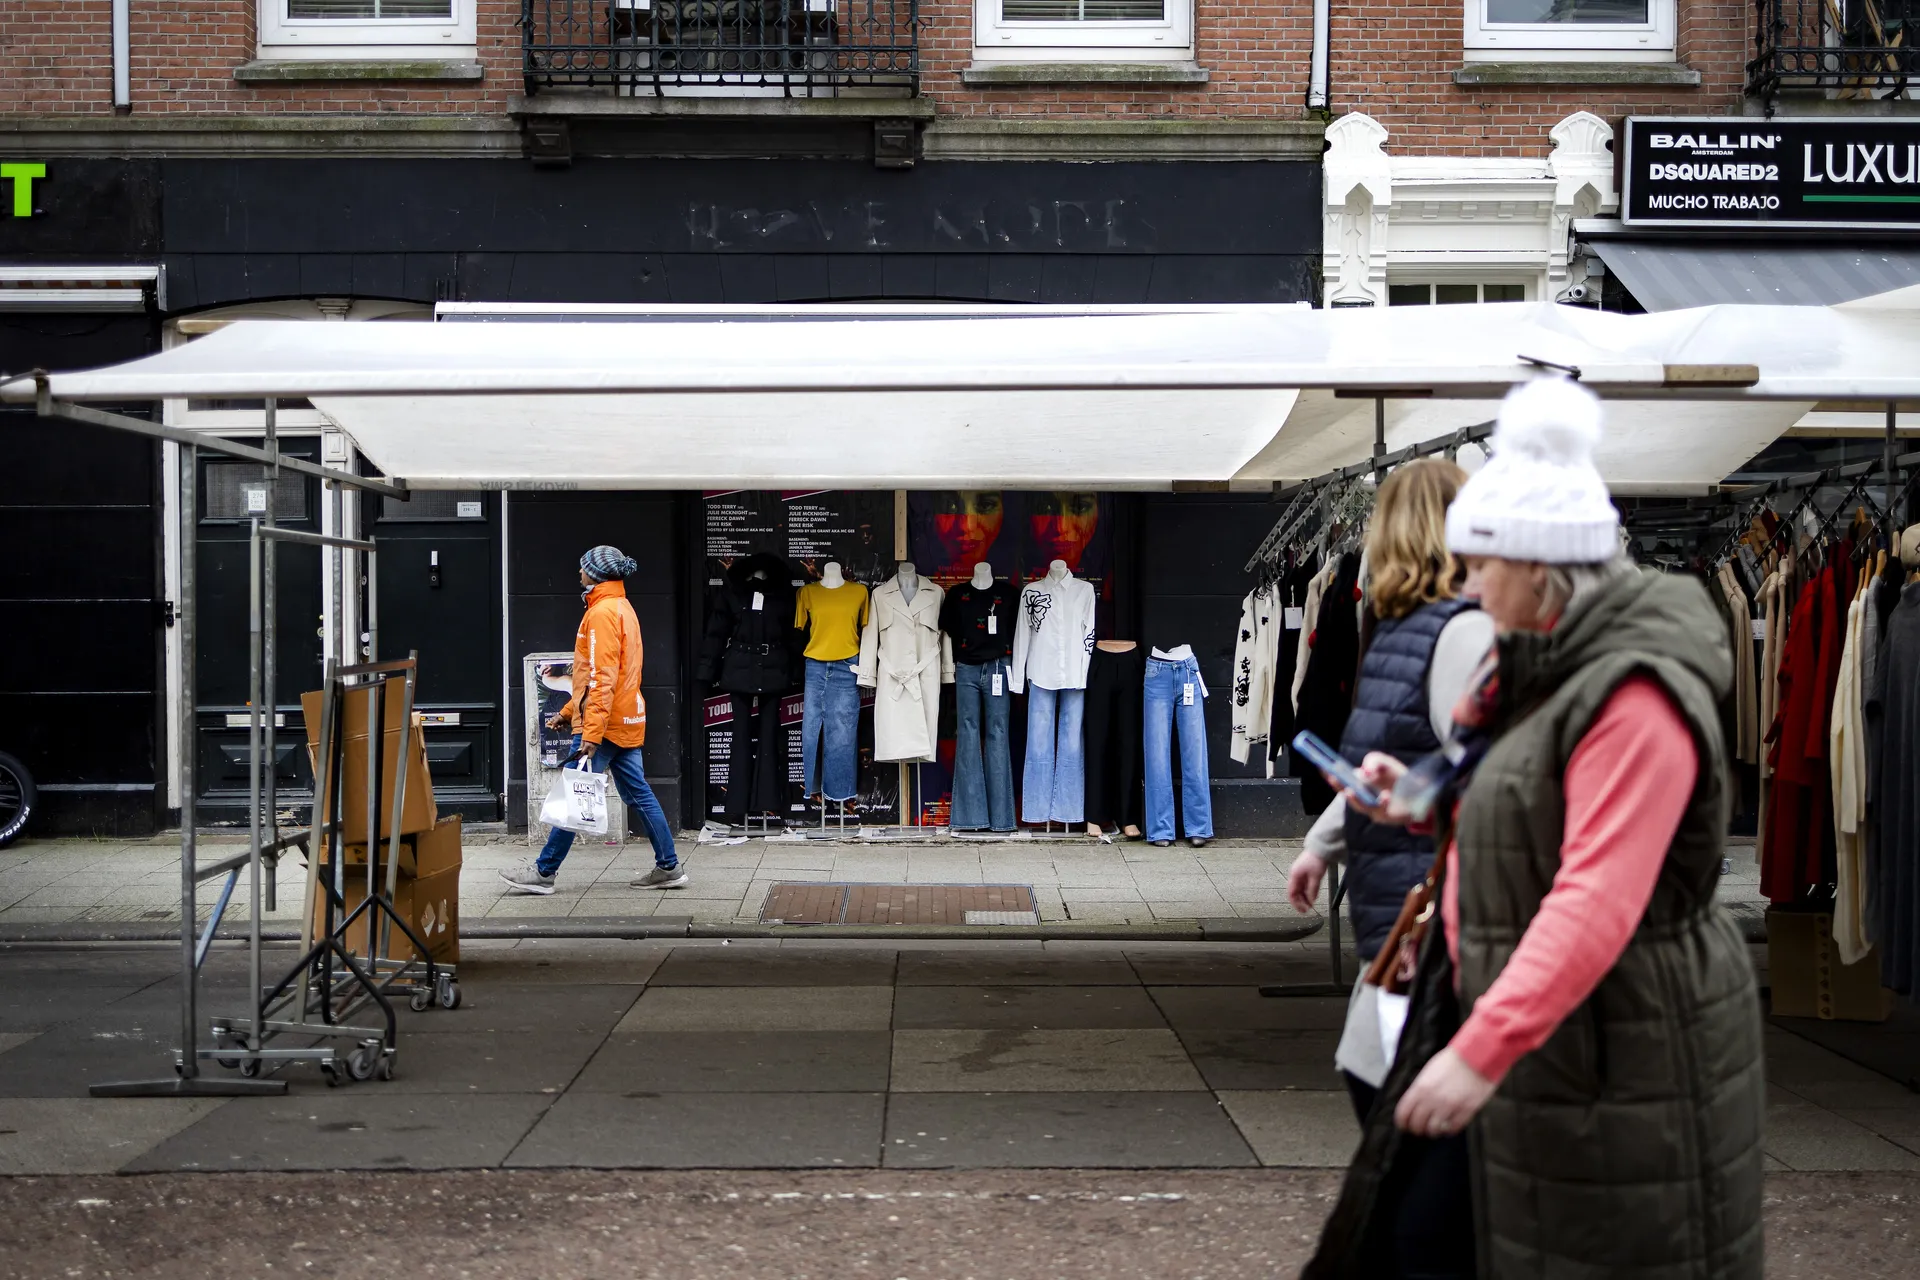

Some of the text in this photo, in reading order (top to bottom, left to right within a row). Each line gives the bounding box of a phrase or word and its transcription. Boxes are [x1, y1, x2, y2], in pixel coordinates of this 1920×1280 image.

[1650, 164, 1779, 181] DSQUARED2
[1649, 195, 1780, 209] MUCHO TRABAJO
[787, 702, 804, 715] TOD
